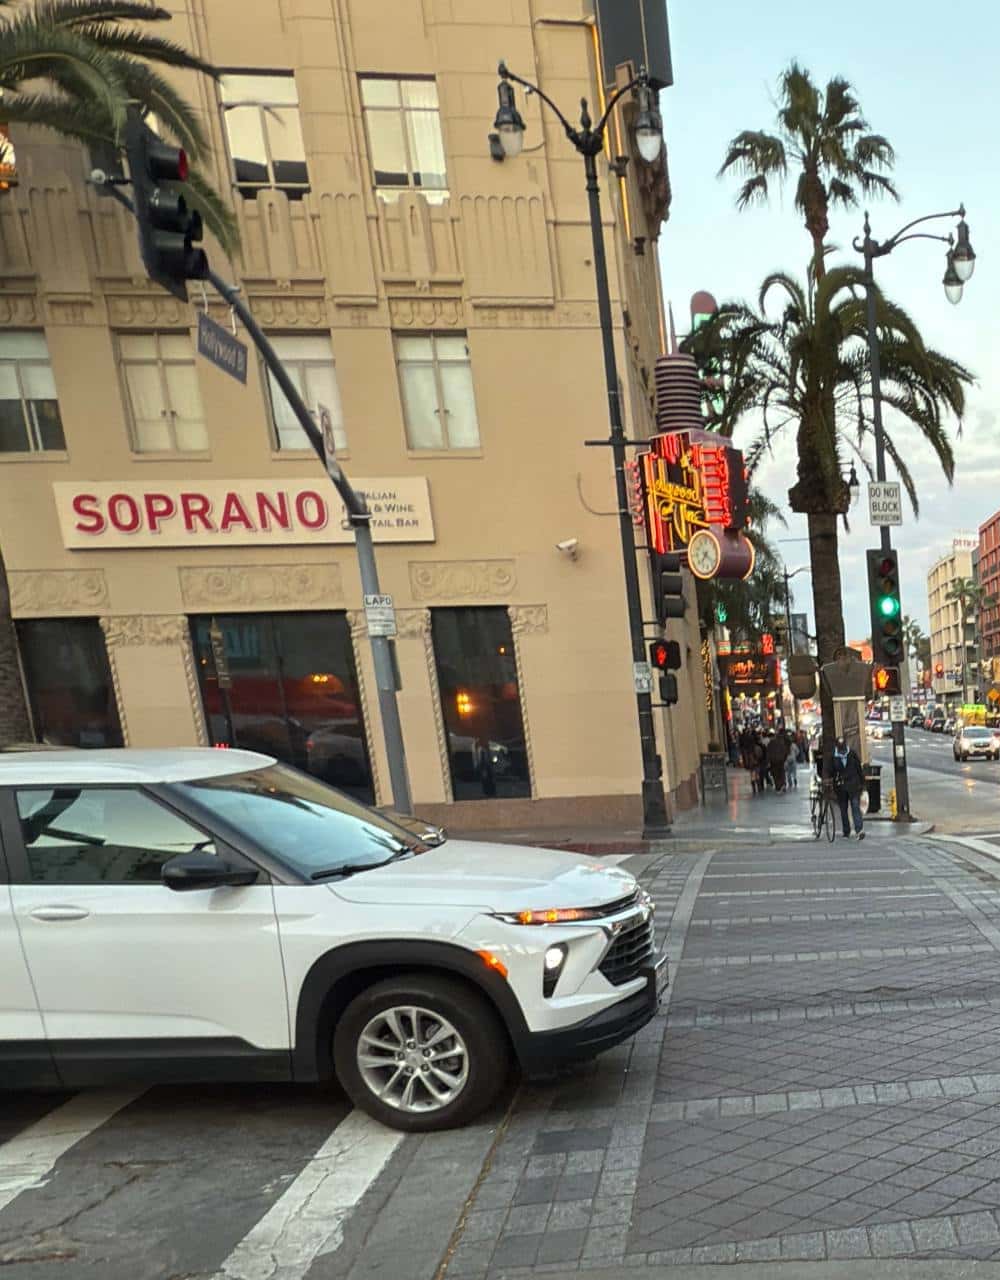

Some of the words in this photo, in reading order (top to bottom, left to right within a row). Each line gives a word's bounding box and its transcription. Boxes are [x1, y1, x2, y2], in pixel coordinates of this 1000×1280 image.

[870, 487, 881, 498] DO
[883, 487, 898, 498] NOT
[71, 490, 329, 533] SOPRANO
[384, 503, 416, 513] WINE
[872, 501, 898, 512] BLOCK
